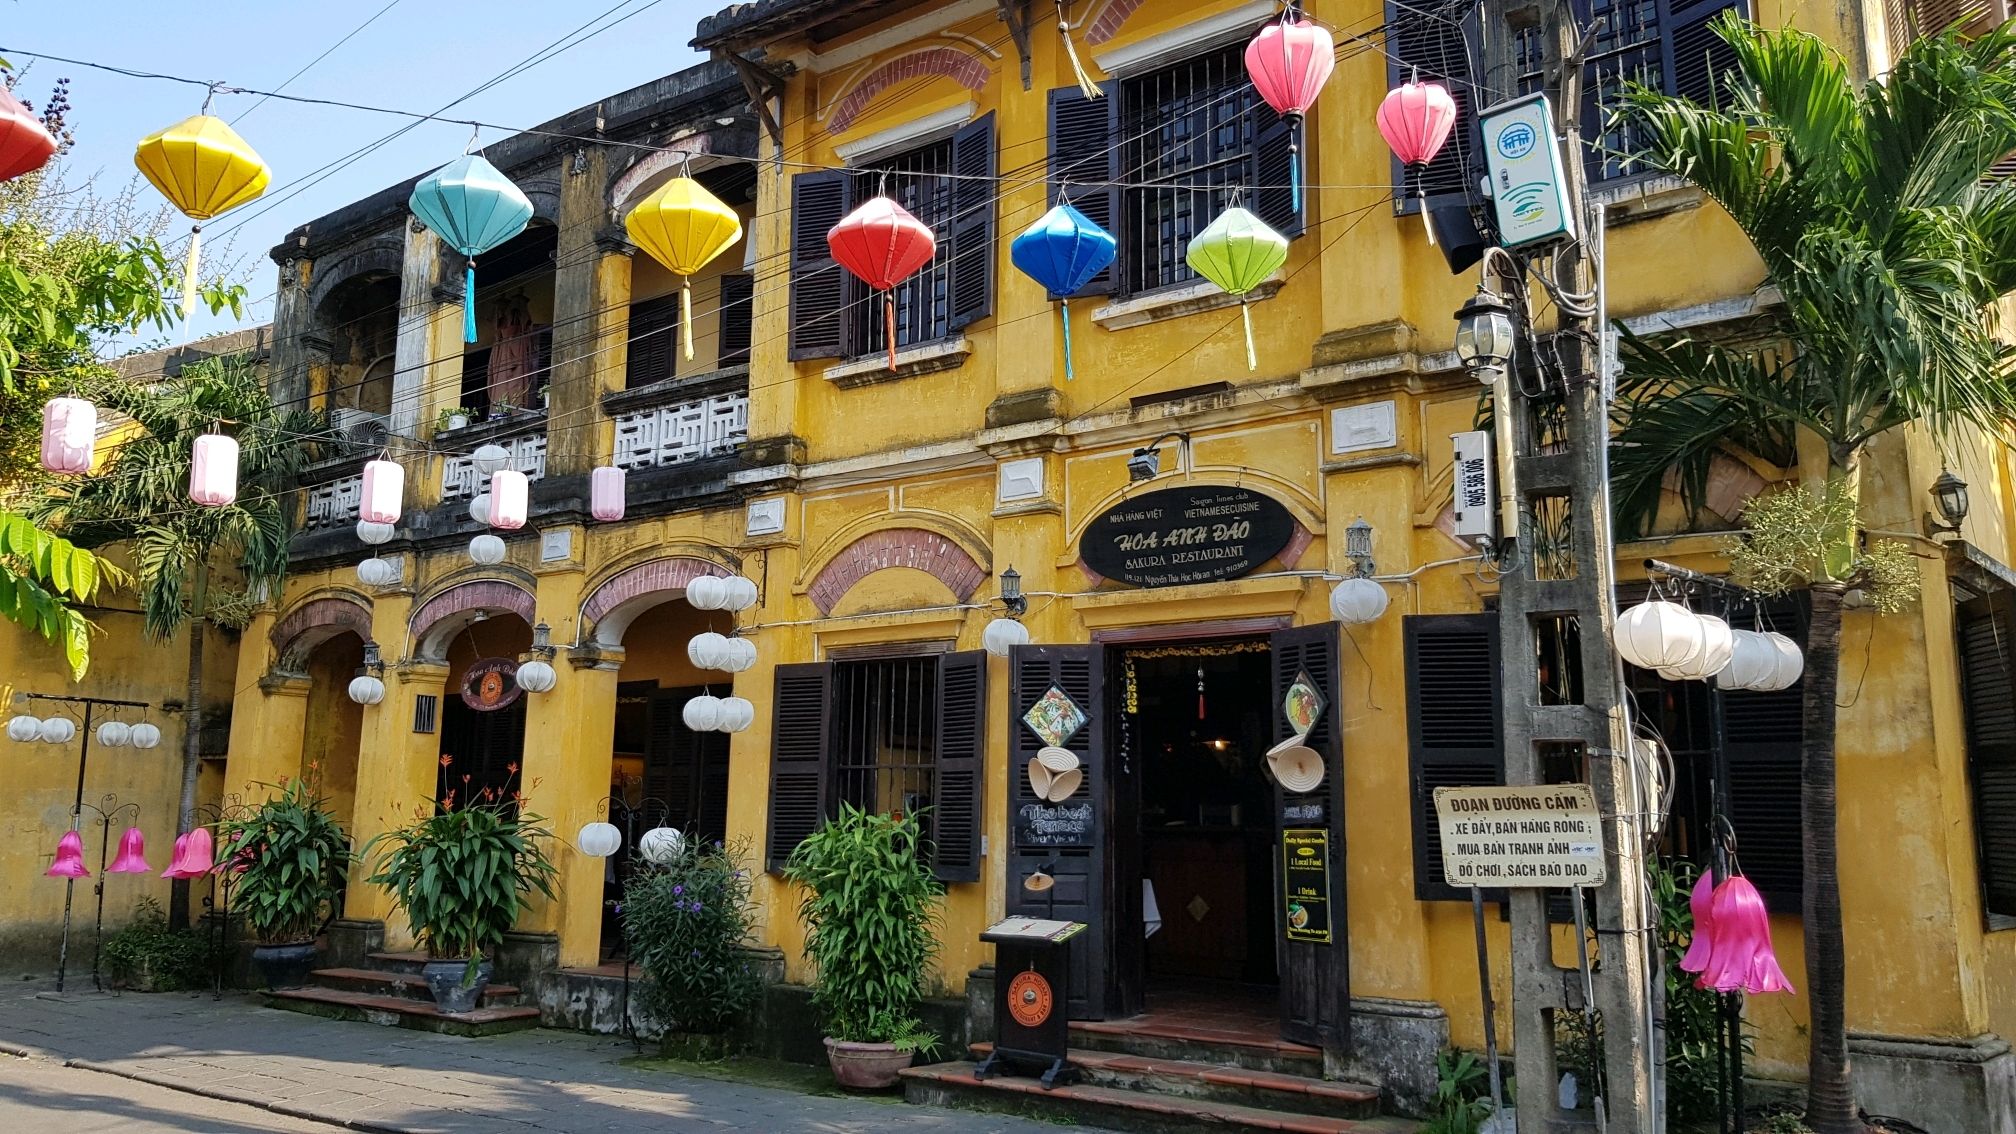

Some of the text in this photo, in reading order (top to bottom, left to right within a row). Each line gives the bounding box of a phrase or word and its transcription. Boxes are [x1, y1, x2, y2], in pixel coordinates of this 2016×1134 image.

[1512, 206, 1544, 218] VIETTEL
[1190, 496, 1213, 507] Saigon
[1113, 531, 1158, 551] HOA
[1162, 526, 1208, 547] ANH
[1125, 545, 1244, 570] SAKURA RESTAURANT
[1020, 803, 1092, 821] The best
[1450, 798, 1490, 815] ĐOẠN
[1492, 793, 1542, 811] ĐƯỜNG
[1031, 819, 1086, 834] Terrace
[1457, 843, 1481, 856] MUA
[1483, 840, 1506, 856] BÁN
[1508, 842, 1544, 855] TRANH
[1547, 837, 1570, 855] ẢNH
[1295, 857, 1309, 866] Local
[1309, 857, 1322, 867] Food
[1539, 861, 1562, 877] BÁO
[1565, 863, 1588, 877] DAO
[1302, 887, 1317, 896] Drink
